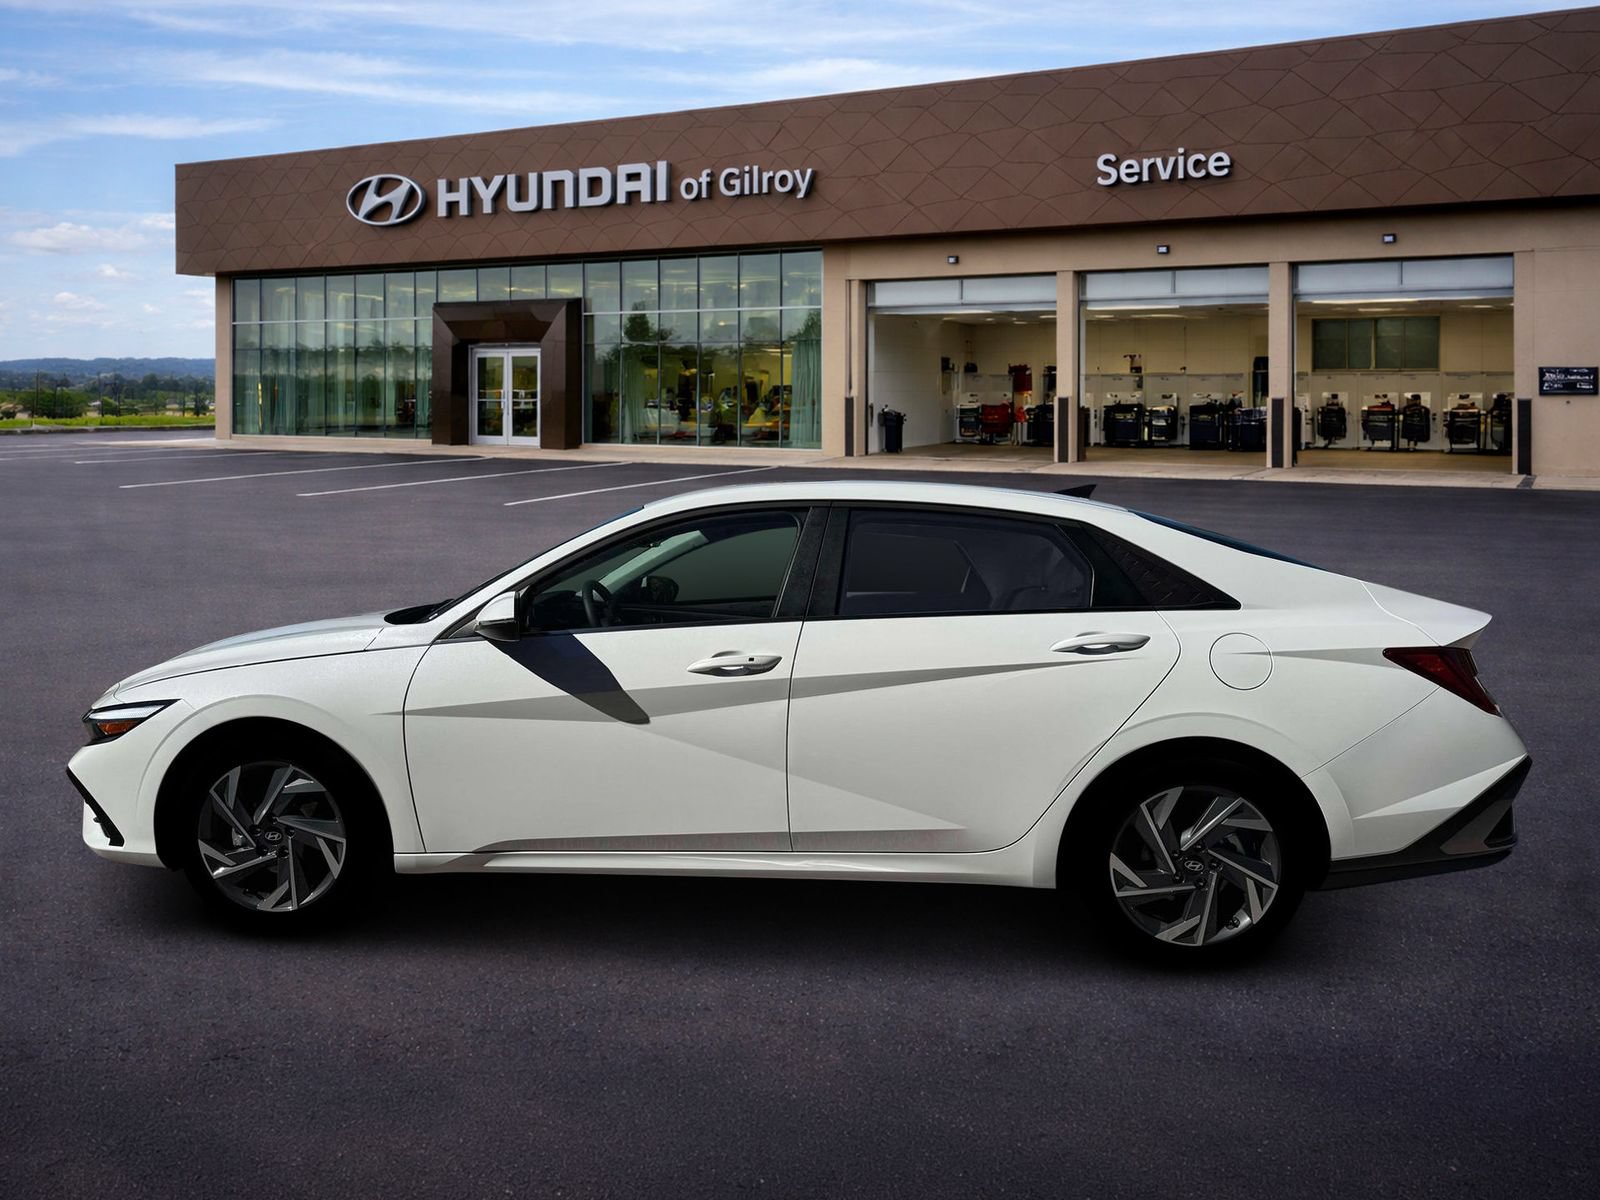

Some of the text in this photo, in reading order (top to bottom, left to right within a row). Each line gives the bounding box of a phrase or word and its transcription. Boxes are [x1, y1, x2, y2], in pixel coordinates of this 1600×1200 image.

[436, 160, 813, 218] HYUNDAI of Gilroy
[1096, 147, 1231, 186] Service
